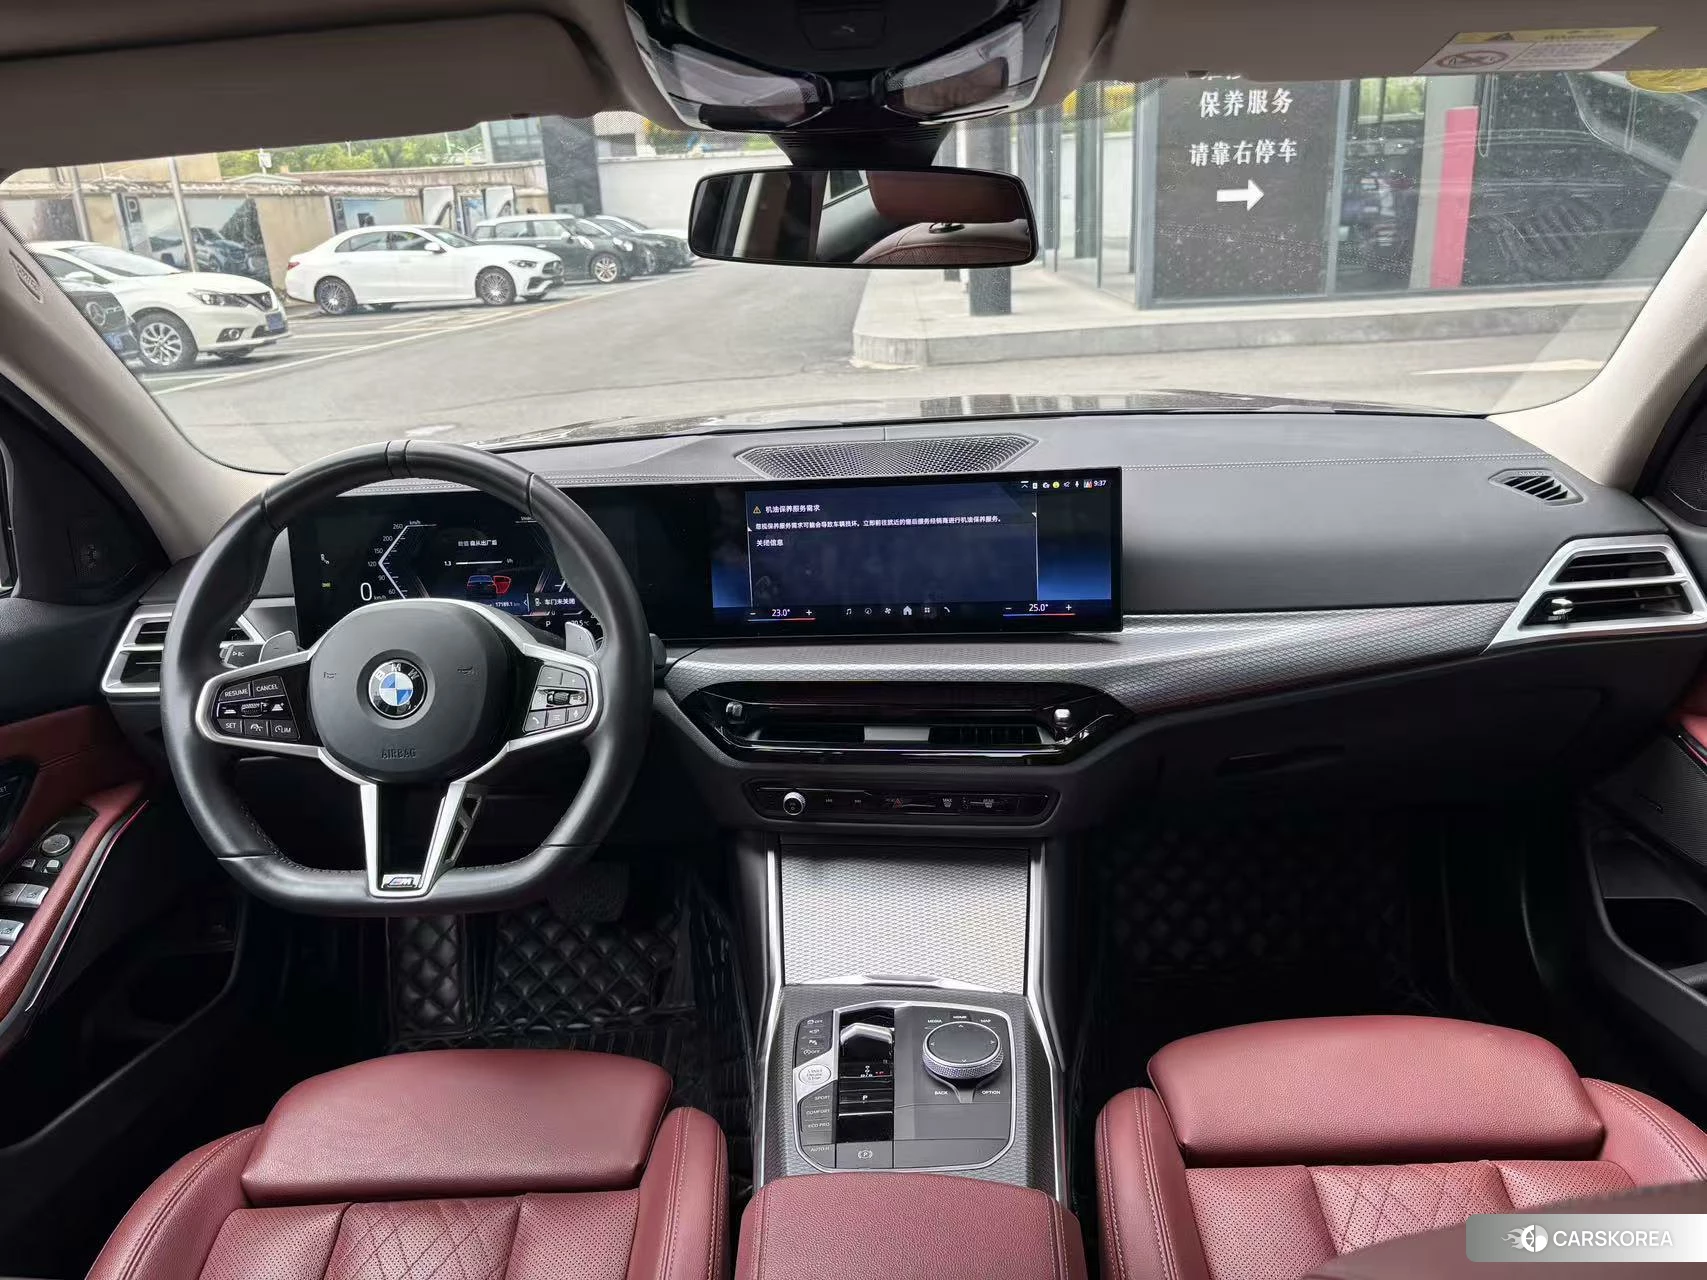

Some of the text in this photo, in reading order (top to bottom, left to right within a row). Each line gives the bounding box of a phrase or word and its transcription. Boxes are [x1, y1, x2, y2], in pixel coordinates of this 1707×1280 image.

[1199, 88, 1293, 118] 保养服务
[1189, 138, 1297, 167] 请靠右停车
[765, 504, 820, 513] 机油保养服务需求
[756, 539, 784, 547] 关闭信息
[360, 582, 373, 601] 0
[544, 598, 576, 606] 车门未关闭
[374, 663, 420, 681] BMW
[224, 688, 249, 697] RESUME
[256, 684, 278, 692] CANCEL
[381, 748, 416, 760] AIRBAG
